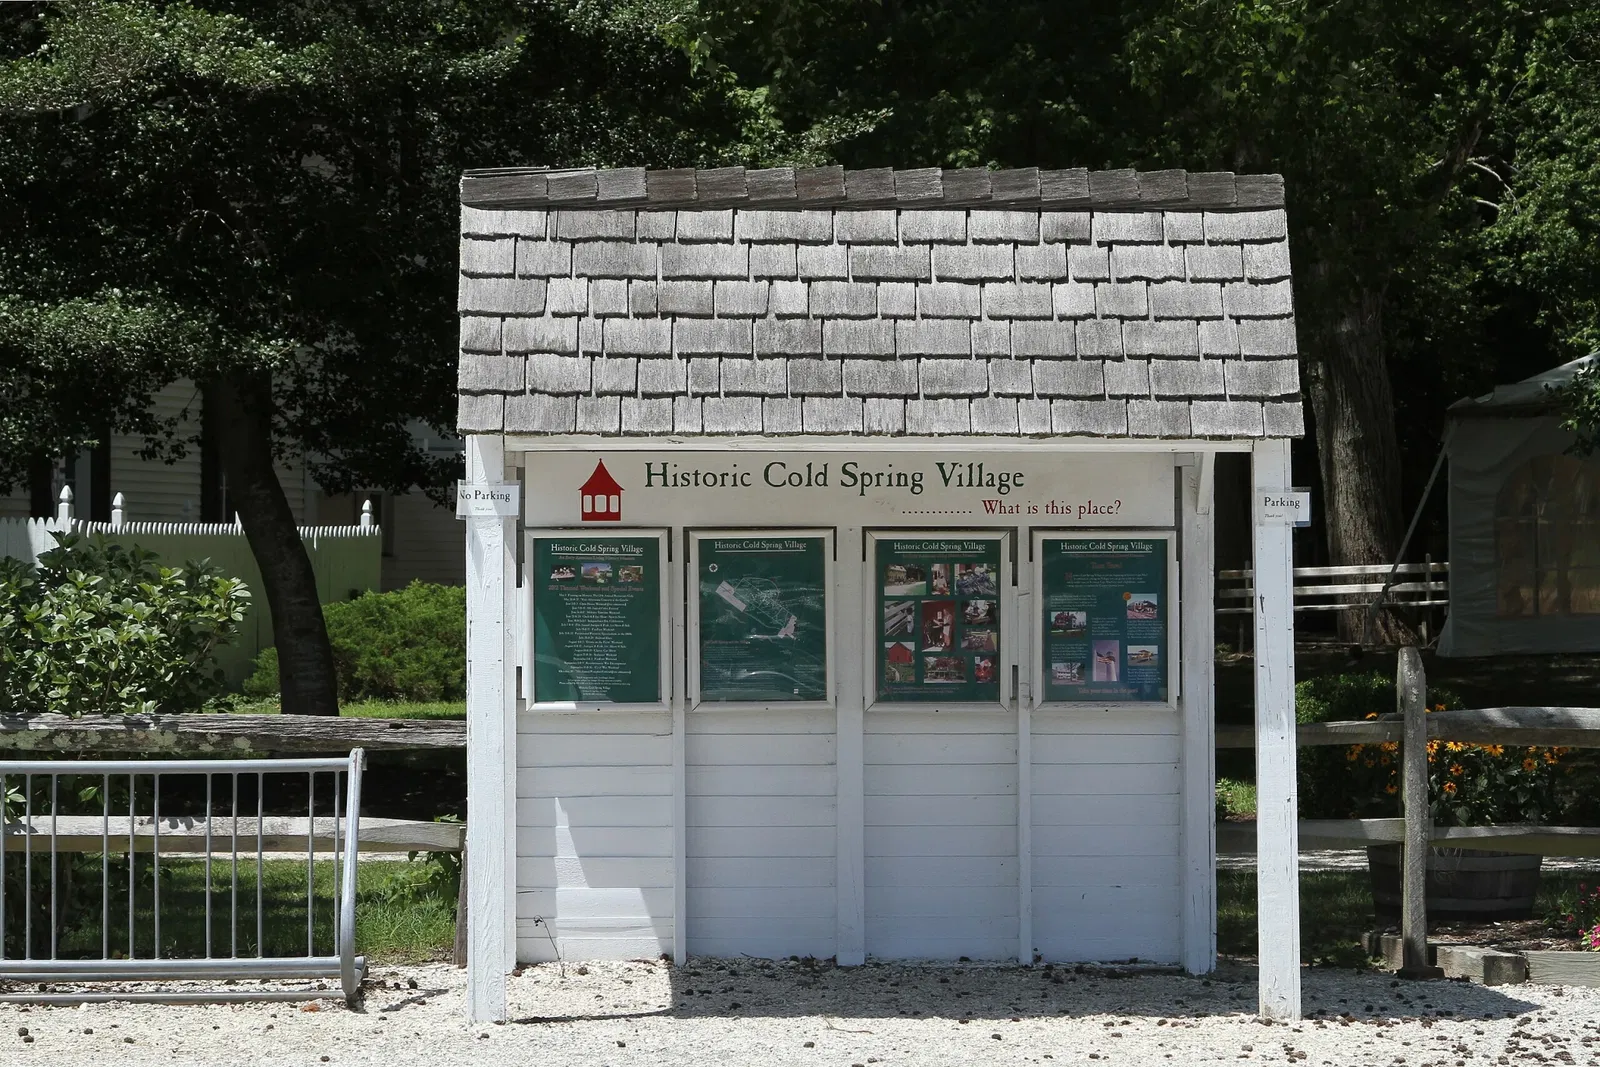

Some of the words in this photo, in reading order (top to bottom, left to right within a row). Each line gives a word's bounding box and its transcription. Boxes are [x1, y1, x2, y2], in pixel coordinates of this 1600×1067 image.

[645, 462, 752, 488] Historic
[764, 462, 829, 488] Cold
[840, 462, 924, 496] Spring
[935, 462, 1025, 496] Village
[459, 490, 472, 500] No
[474, 490, 511, 502] Parking
[1264, 497, 1300, 509] Parking
[981, 499, 1021, 515] What
[1027, 500, 1039, 515] is
[1045, 499, 1072, 515] this
[1078, 499, 1122, 519] place?
[579, 544, 597, 552] Cold
[598, 544, 620, 554] Spring
[621, 545, 643, 554] Village
[715, 541, 742, 549] Historic
[761, 540, 783, 550] Spring
[784, 540, 806, 549] Village
[894, 542, 921, 550] Historic
[922, 542, 939, 550] Cold
[940, 542, 962, 552] Spring
[963, 542, 986, 551] Village
[1061, 542, 1088, 550] Historic
[1089, 542, 1106, 550] Cold
[1107, 542, 1129, 552] Spring
[1131, 542, 1152, 551] Village
